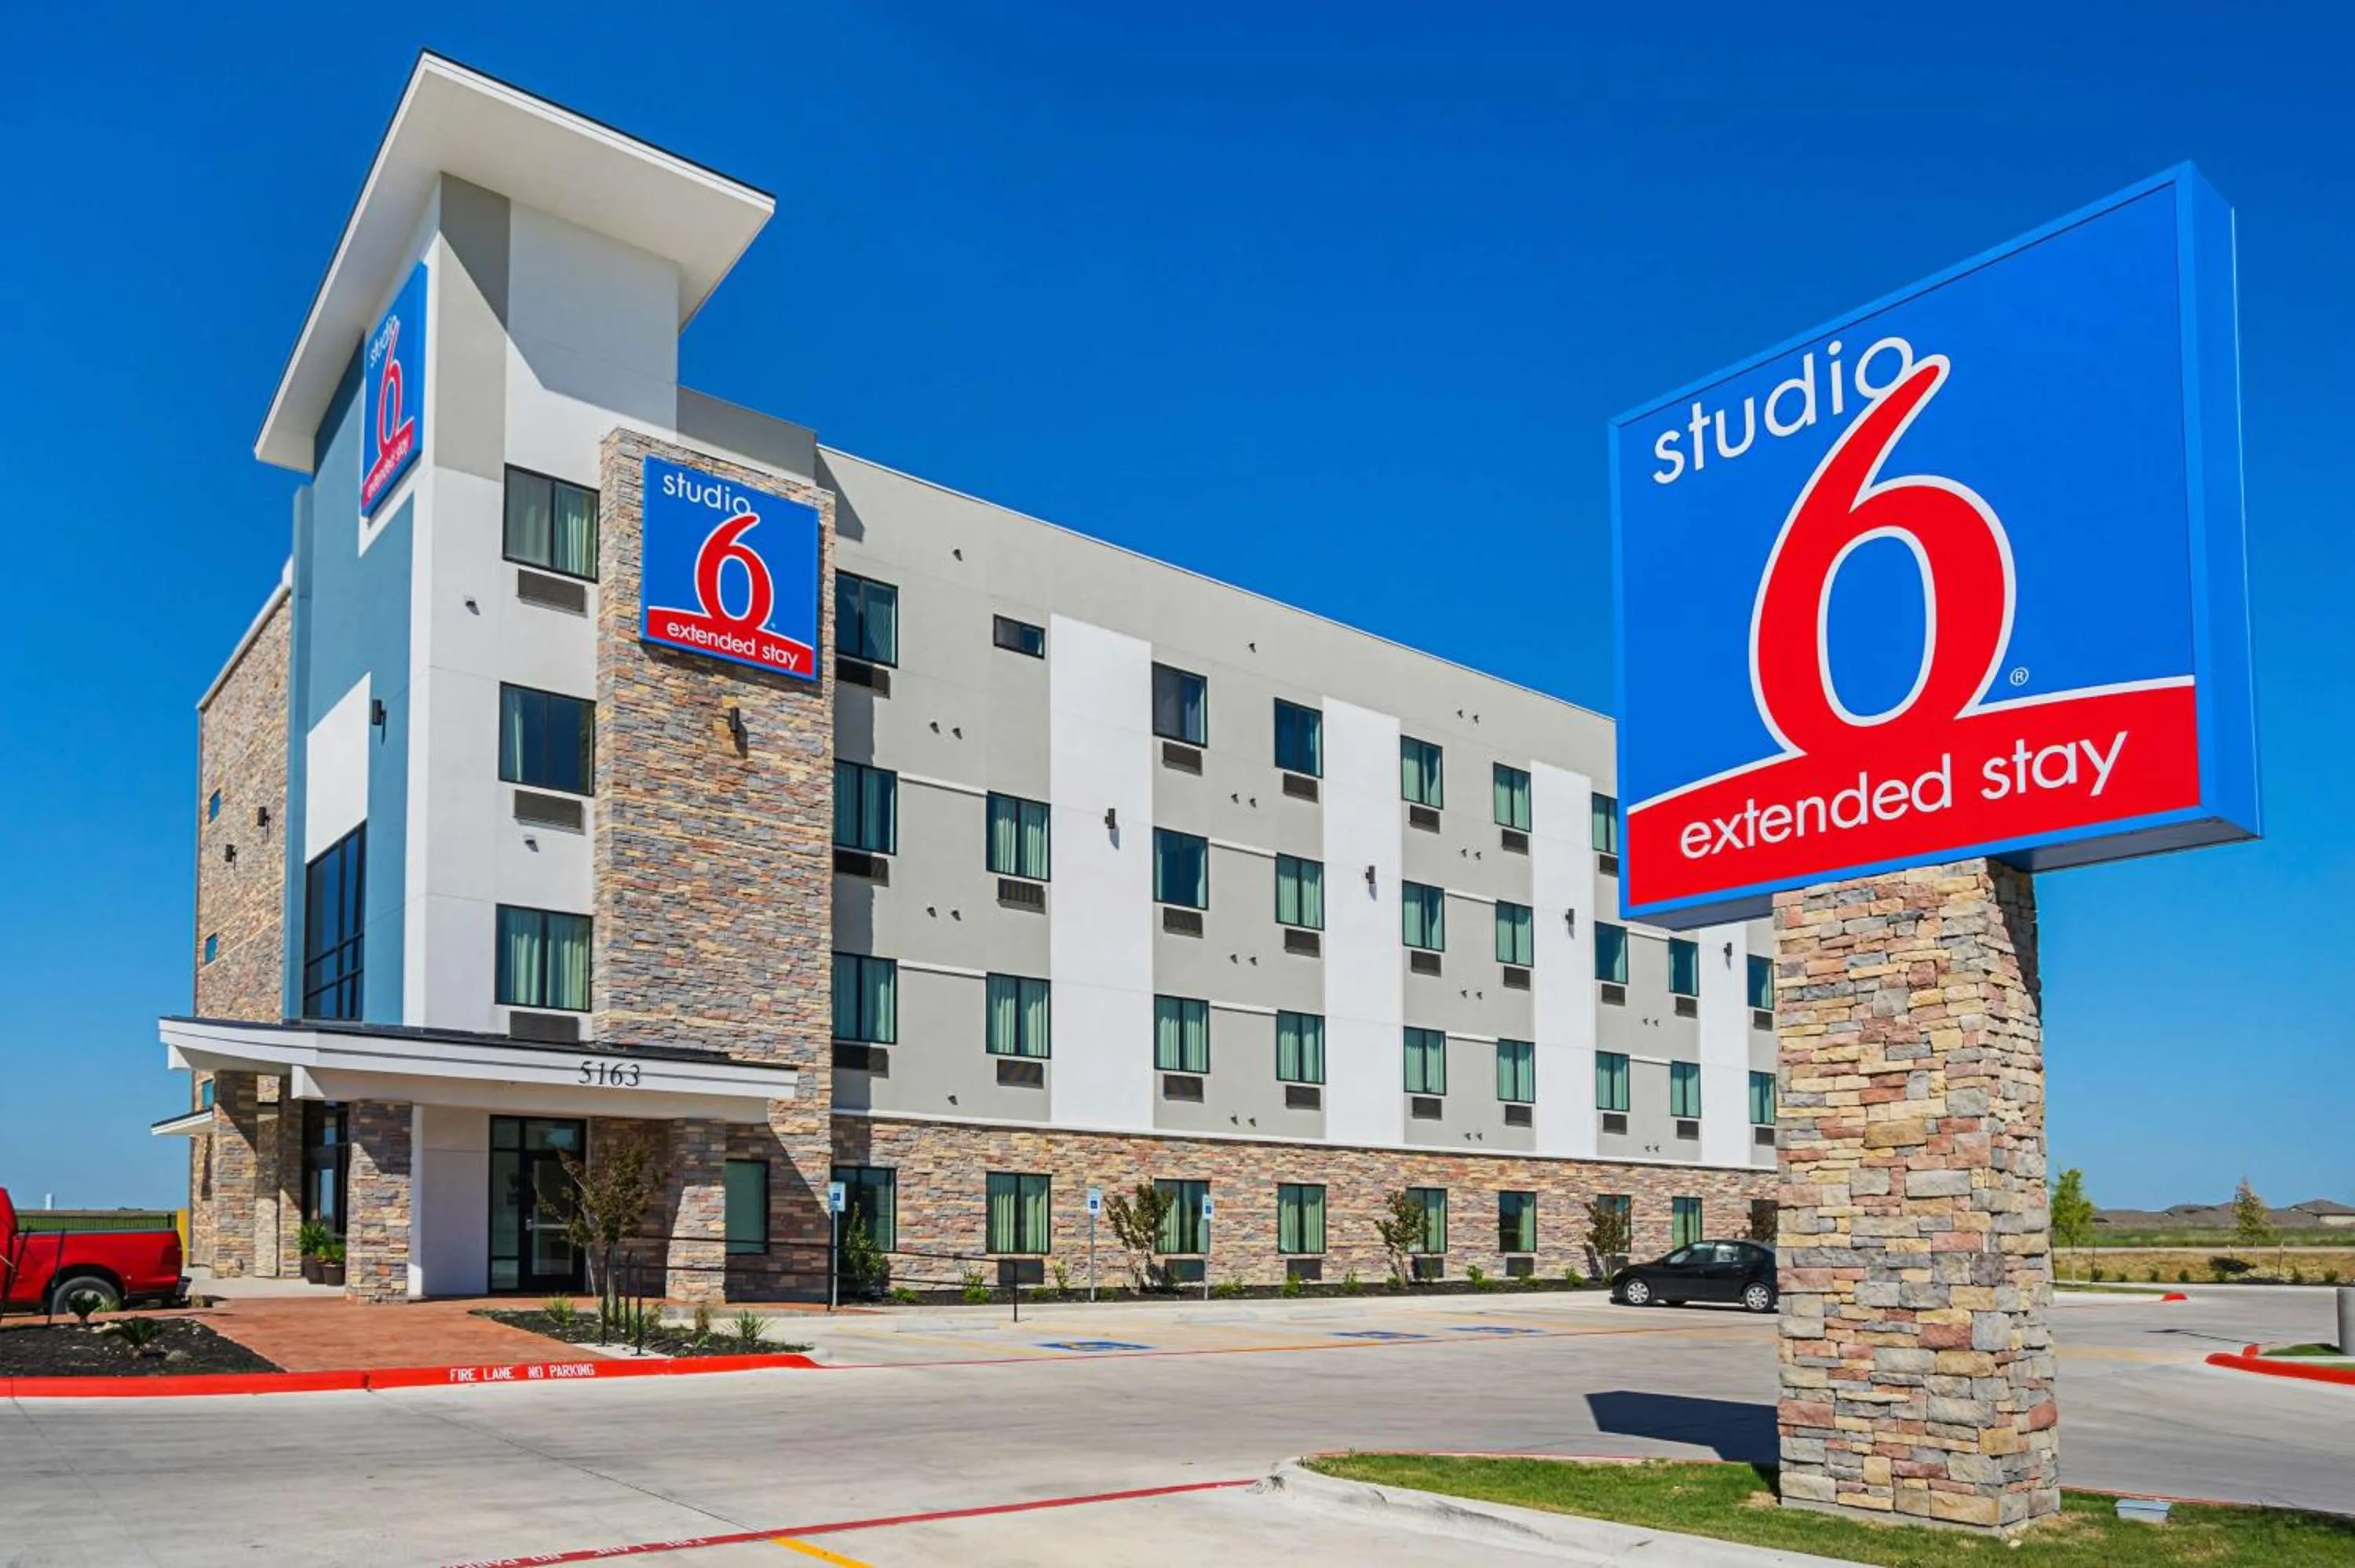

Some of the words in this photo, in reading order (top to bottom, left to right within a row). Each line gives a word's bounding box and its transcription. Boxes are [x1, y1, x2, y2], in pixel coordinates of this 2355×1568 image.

[1652, 336, 1914, 484] studio
[662, 472, 751, 515] studio
[694, 512, 774, 628] 6
[1748, 353, 2017, 756] 6
[666, 622, 756, 656] extended
[761, 644, 798, 670] stay
[1679, 756, 1952, 860] extended
[1981, 731, 2128, 799] stay
[578, 1060, 640, 1087] 5163
[450, 1368, 477, 1382] FIRE
[484, 1366, 515, 1380] LANE
[528, 1366, 543, 1378] NO
[550, 1363, 594, 1378] PARKING
